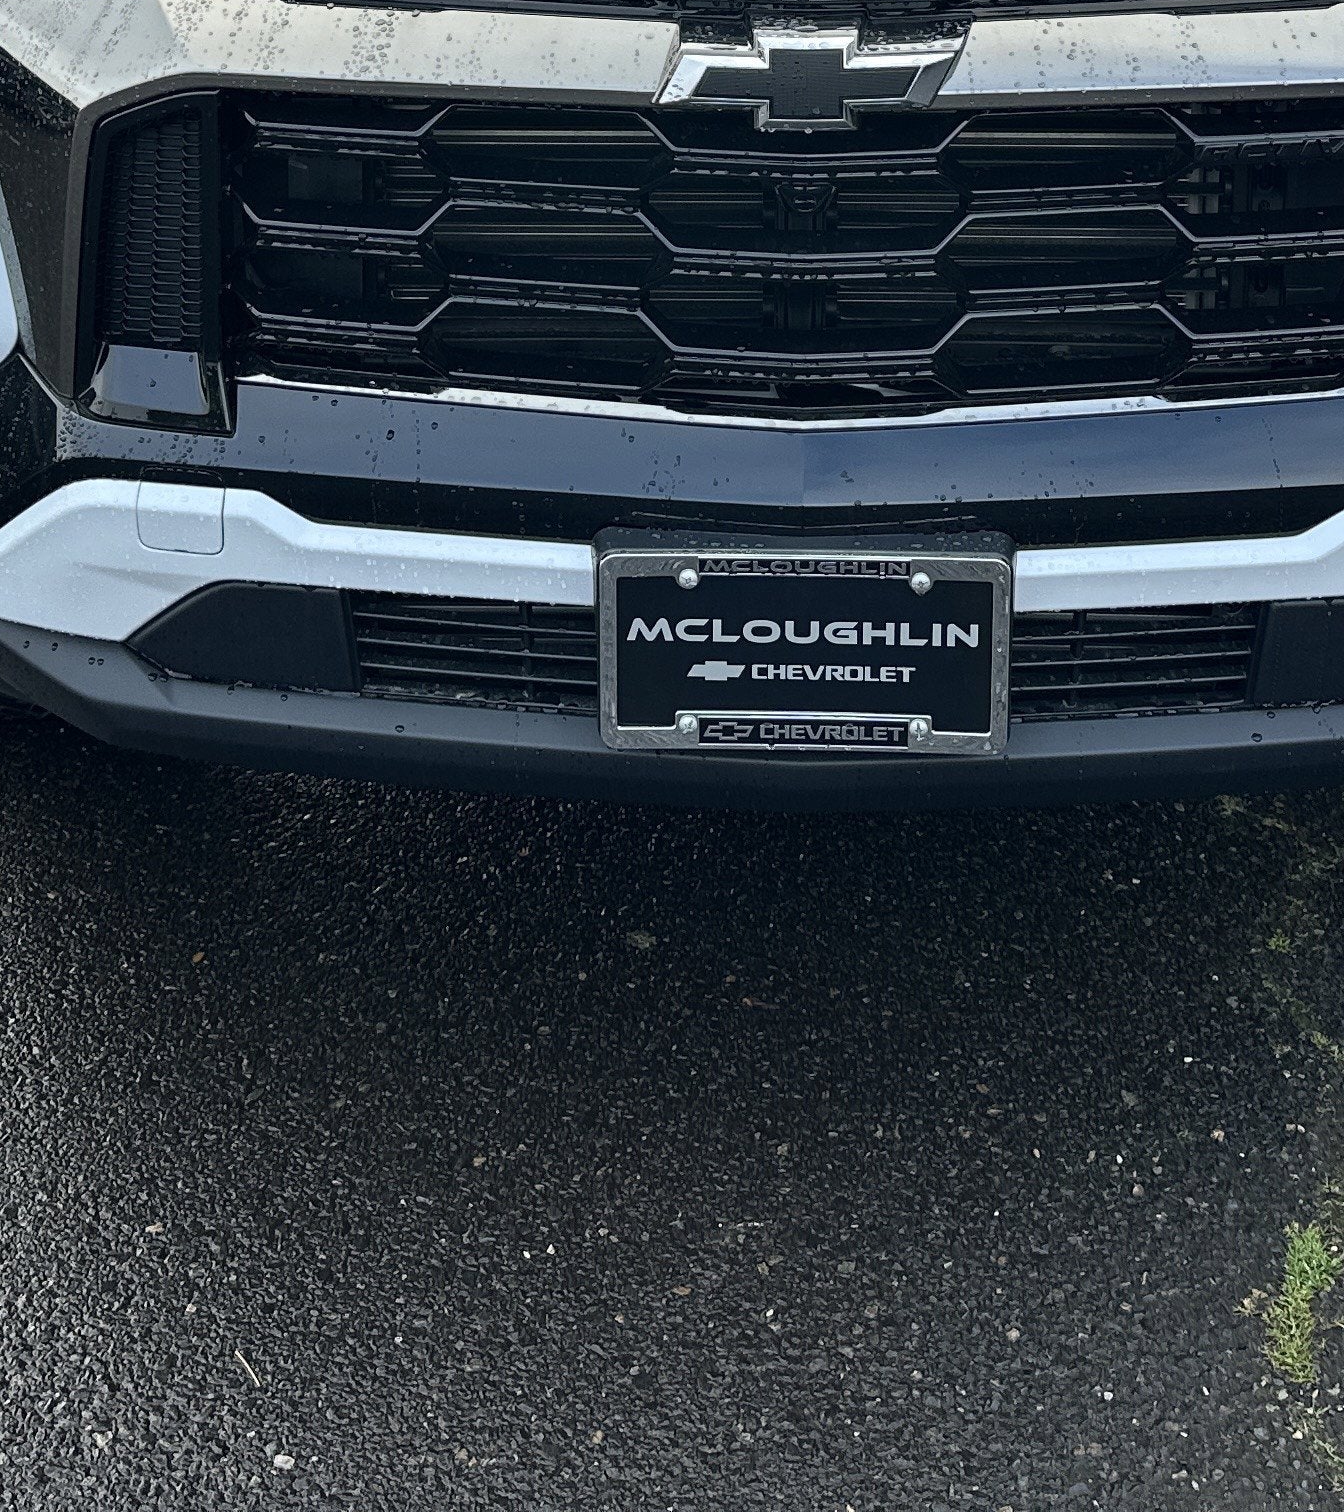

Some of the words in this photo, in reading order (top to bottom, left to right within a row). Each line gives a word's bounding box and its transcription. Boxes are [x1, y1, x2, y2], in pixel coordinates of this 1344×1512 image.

[703, 558, 908, 574] MCLOUGHLIN
[626, 617, 980, 648] MCLOUGHLIN
[751, 663, 916, 683] CHEVROLET
[759, 722, 905, 743] CHEVROLET
